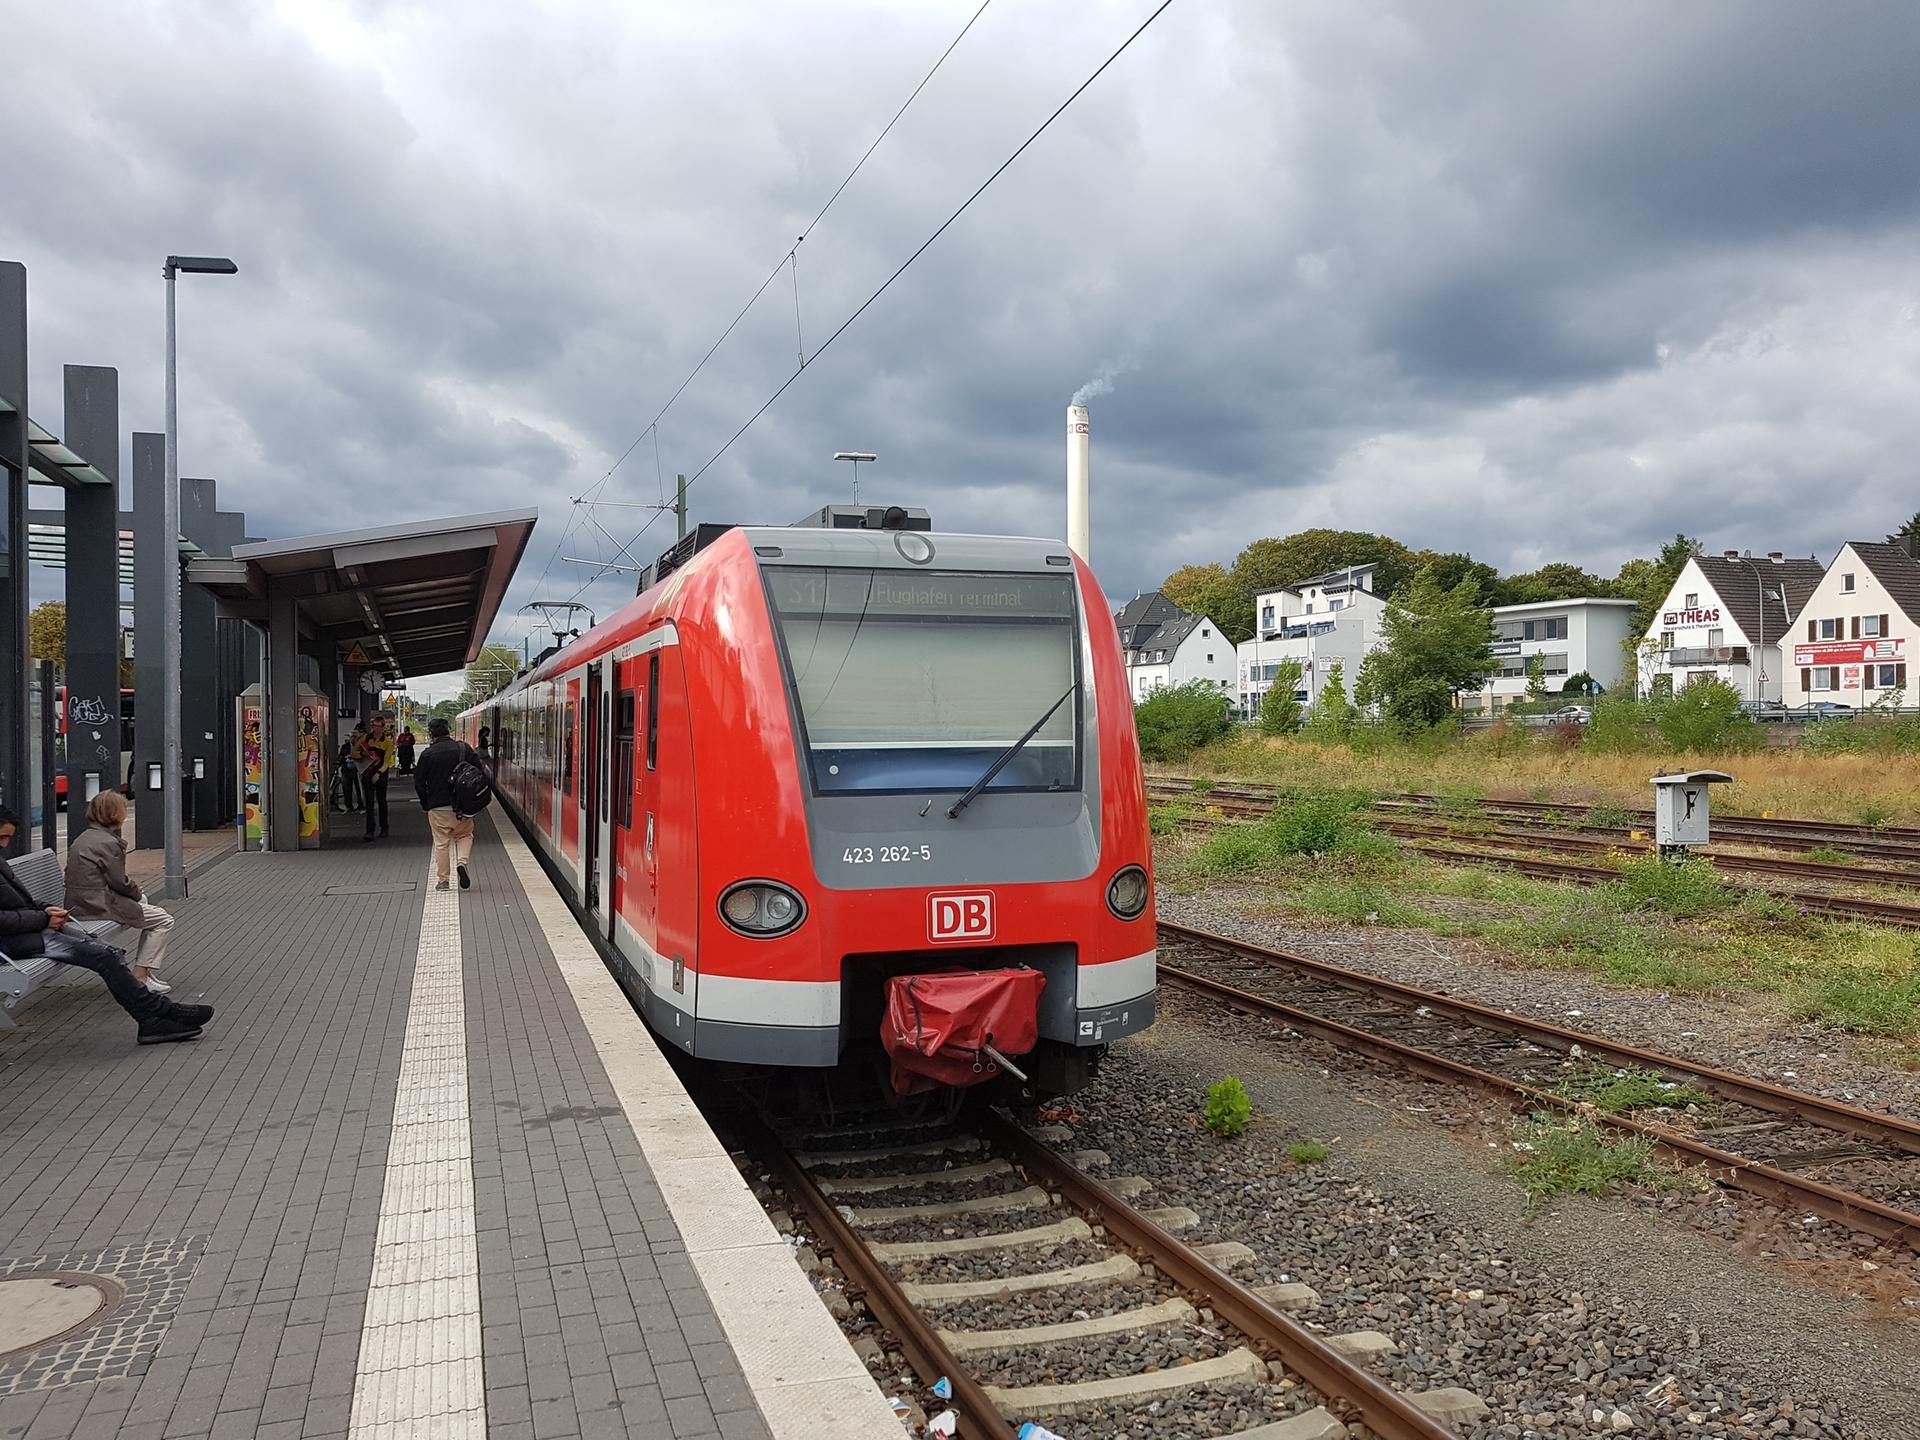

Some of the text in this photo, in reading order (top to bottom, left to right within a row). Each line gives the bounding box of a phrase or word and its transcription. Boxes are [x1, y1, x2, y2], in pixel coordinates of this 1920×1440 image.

[1679, 609, 1720, 624] THEAS
[1686, 791, 1697, 819] F
[842, 845, 931, 864] 423 262-5
[936, 899, 988, 934] DB
